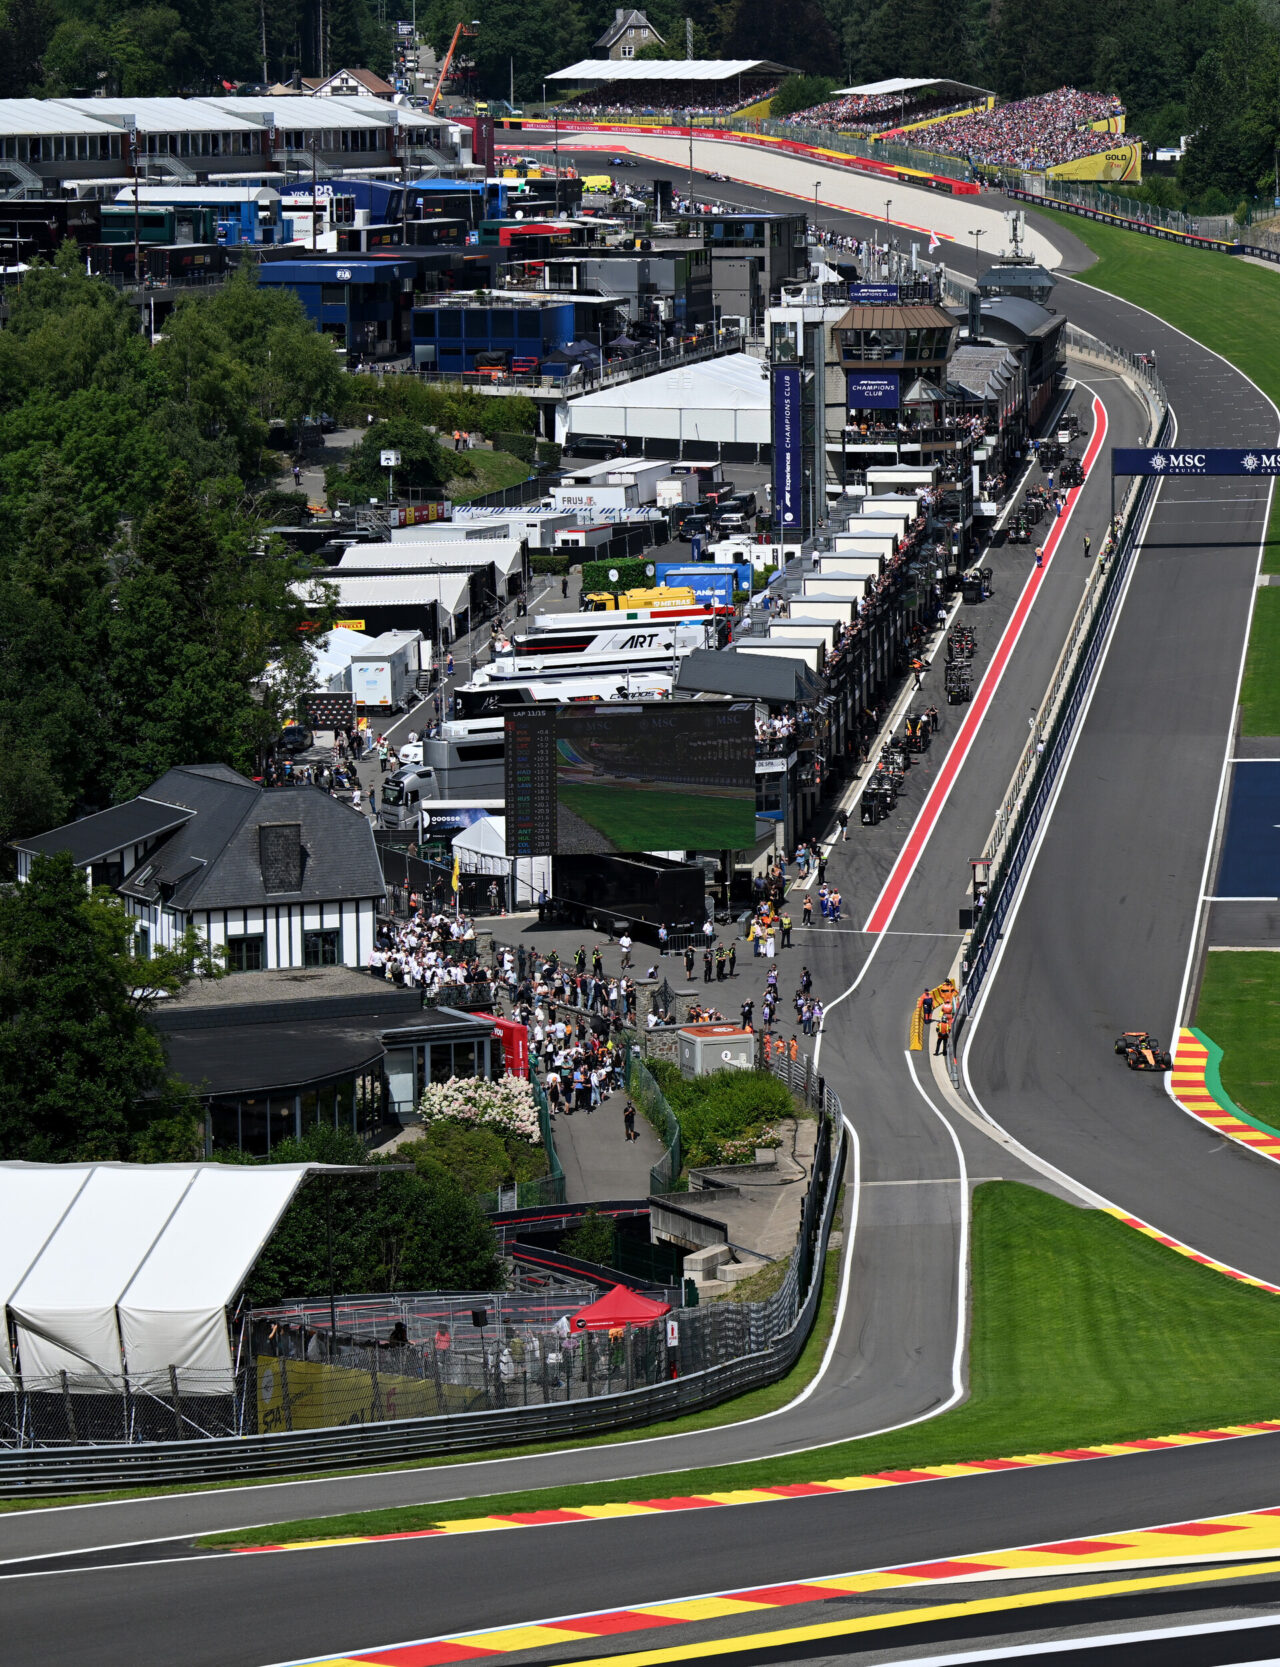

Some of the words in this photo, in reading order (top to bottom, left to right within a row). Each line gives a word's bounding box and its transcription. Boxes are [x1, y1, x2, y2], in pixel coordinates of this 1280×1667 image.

[1169, 454, 1206, 467] MSC
[620, 634, 659, 649] ART
[610, 691, 655, 700] Cmpos
[651, 718, 676, 727] MSC
[716, 715, 741, 724] MSC
